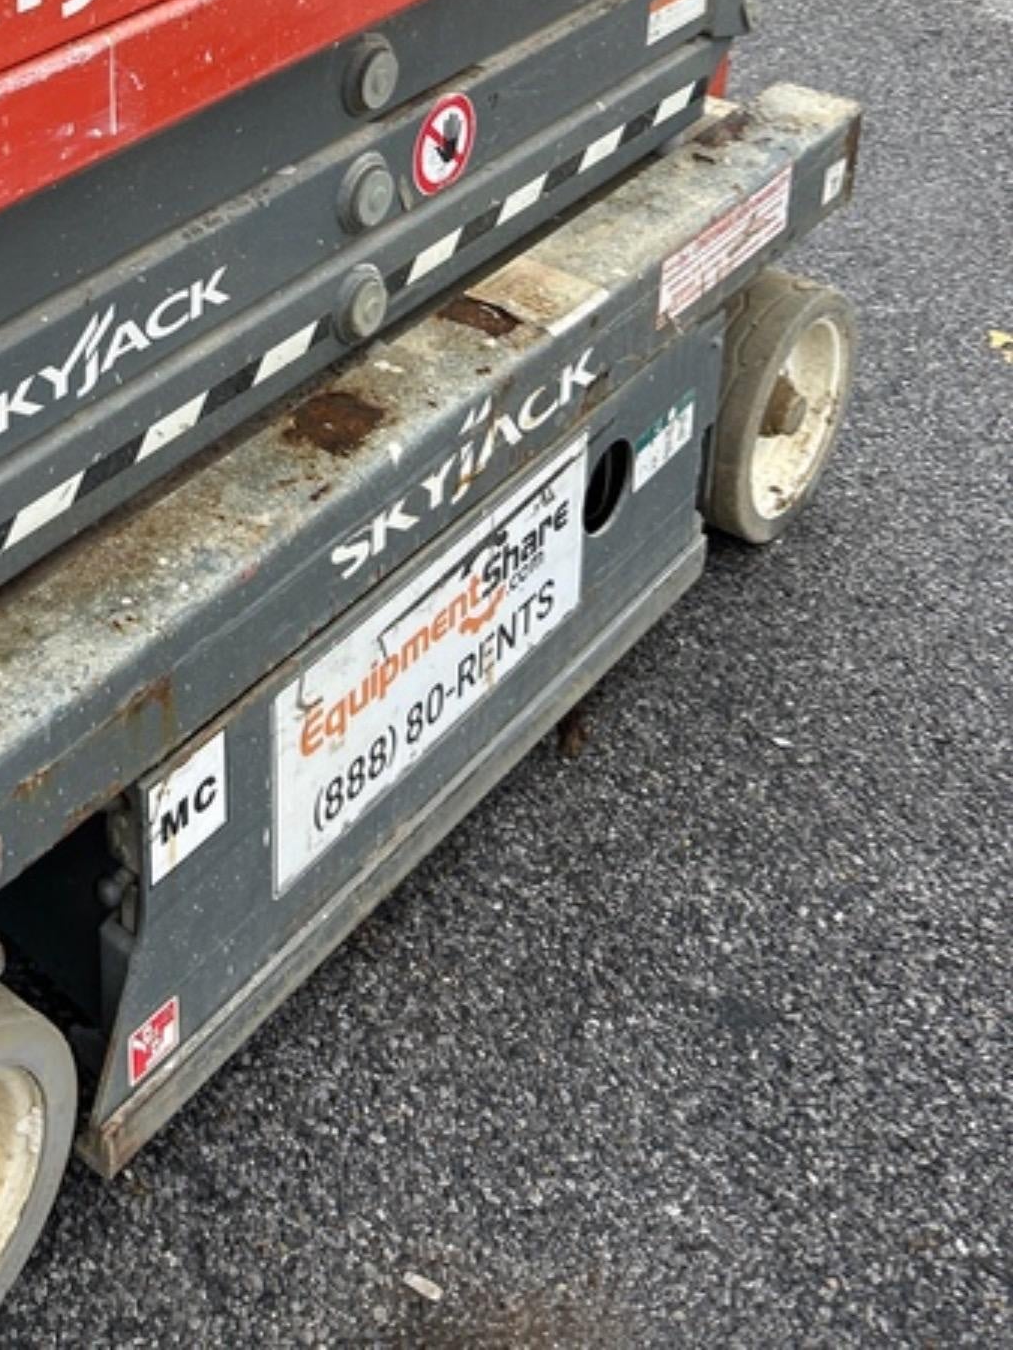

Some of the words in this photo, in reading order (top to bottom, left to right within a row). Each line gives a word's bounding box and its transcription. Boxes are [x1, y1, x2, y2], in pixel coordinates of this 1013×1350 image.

[331, 347, 598, 580] SKYJACK
[160, 775, 218, 846] MC
[313, 725, 397, 832] (888)
[406, 579, 556, 745] 80-RENTS
